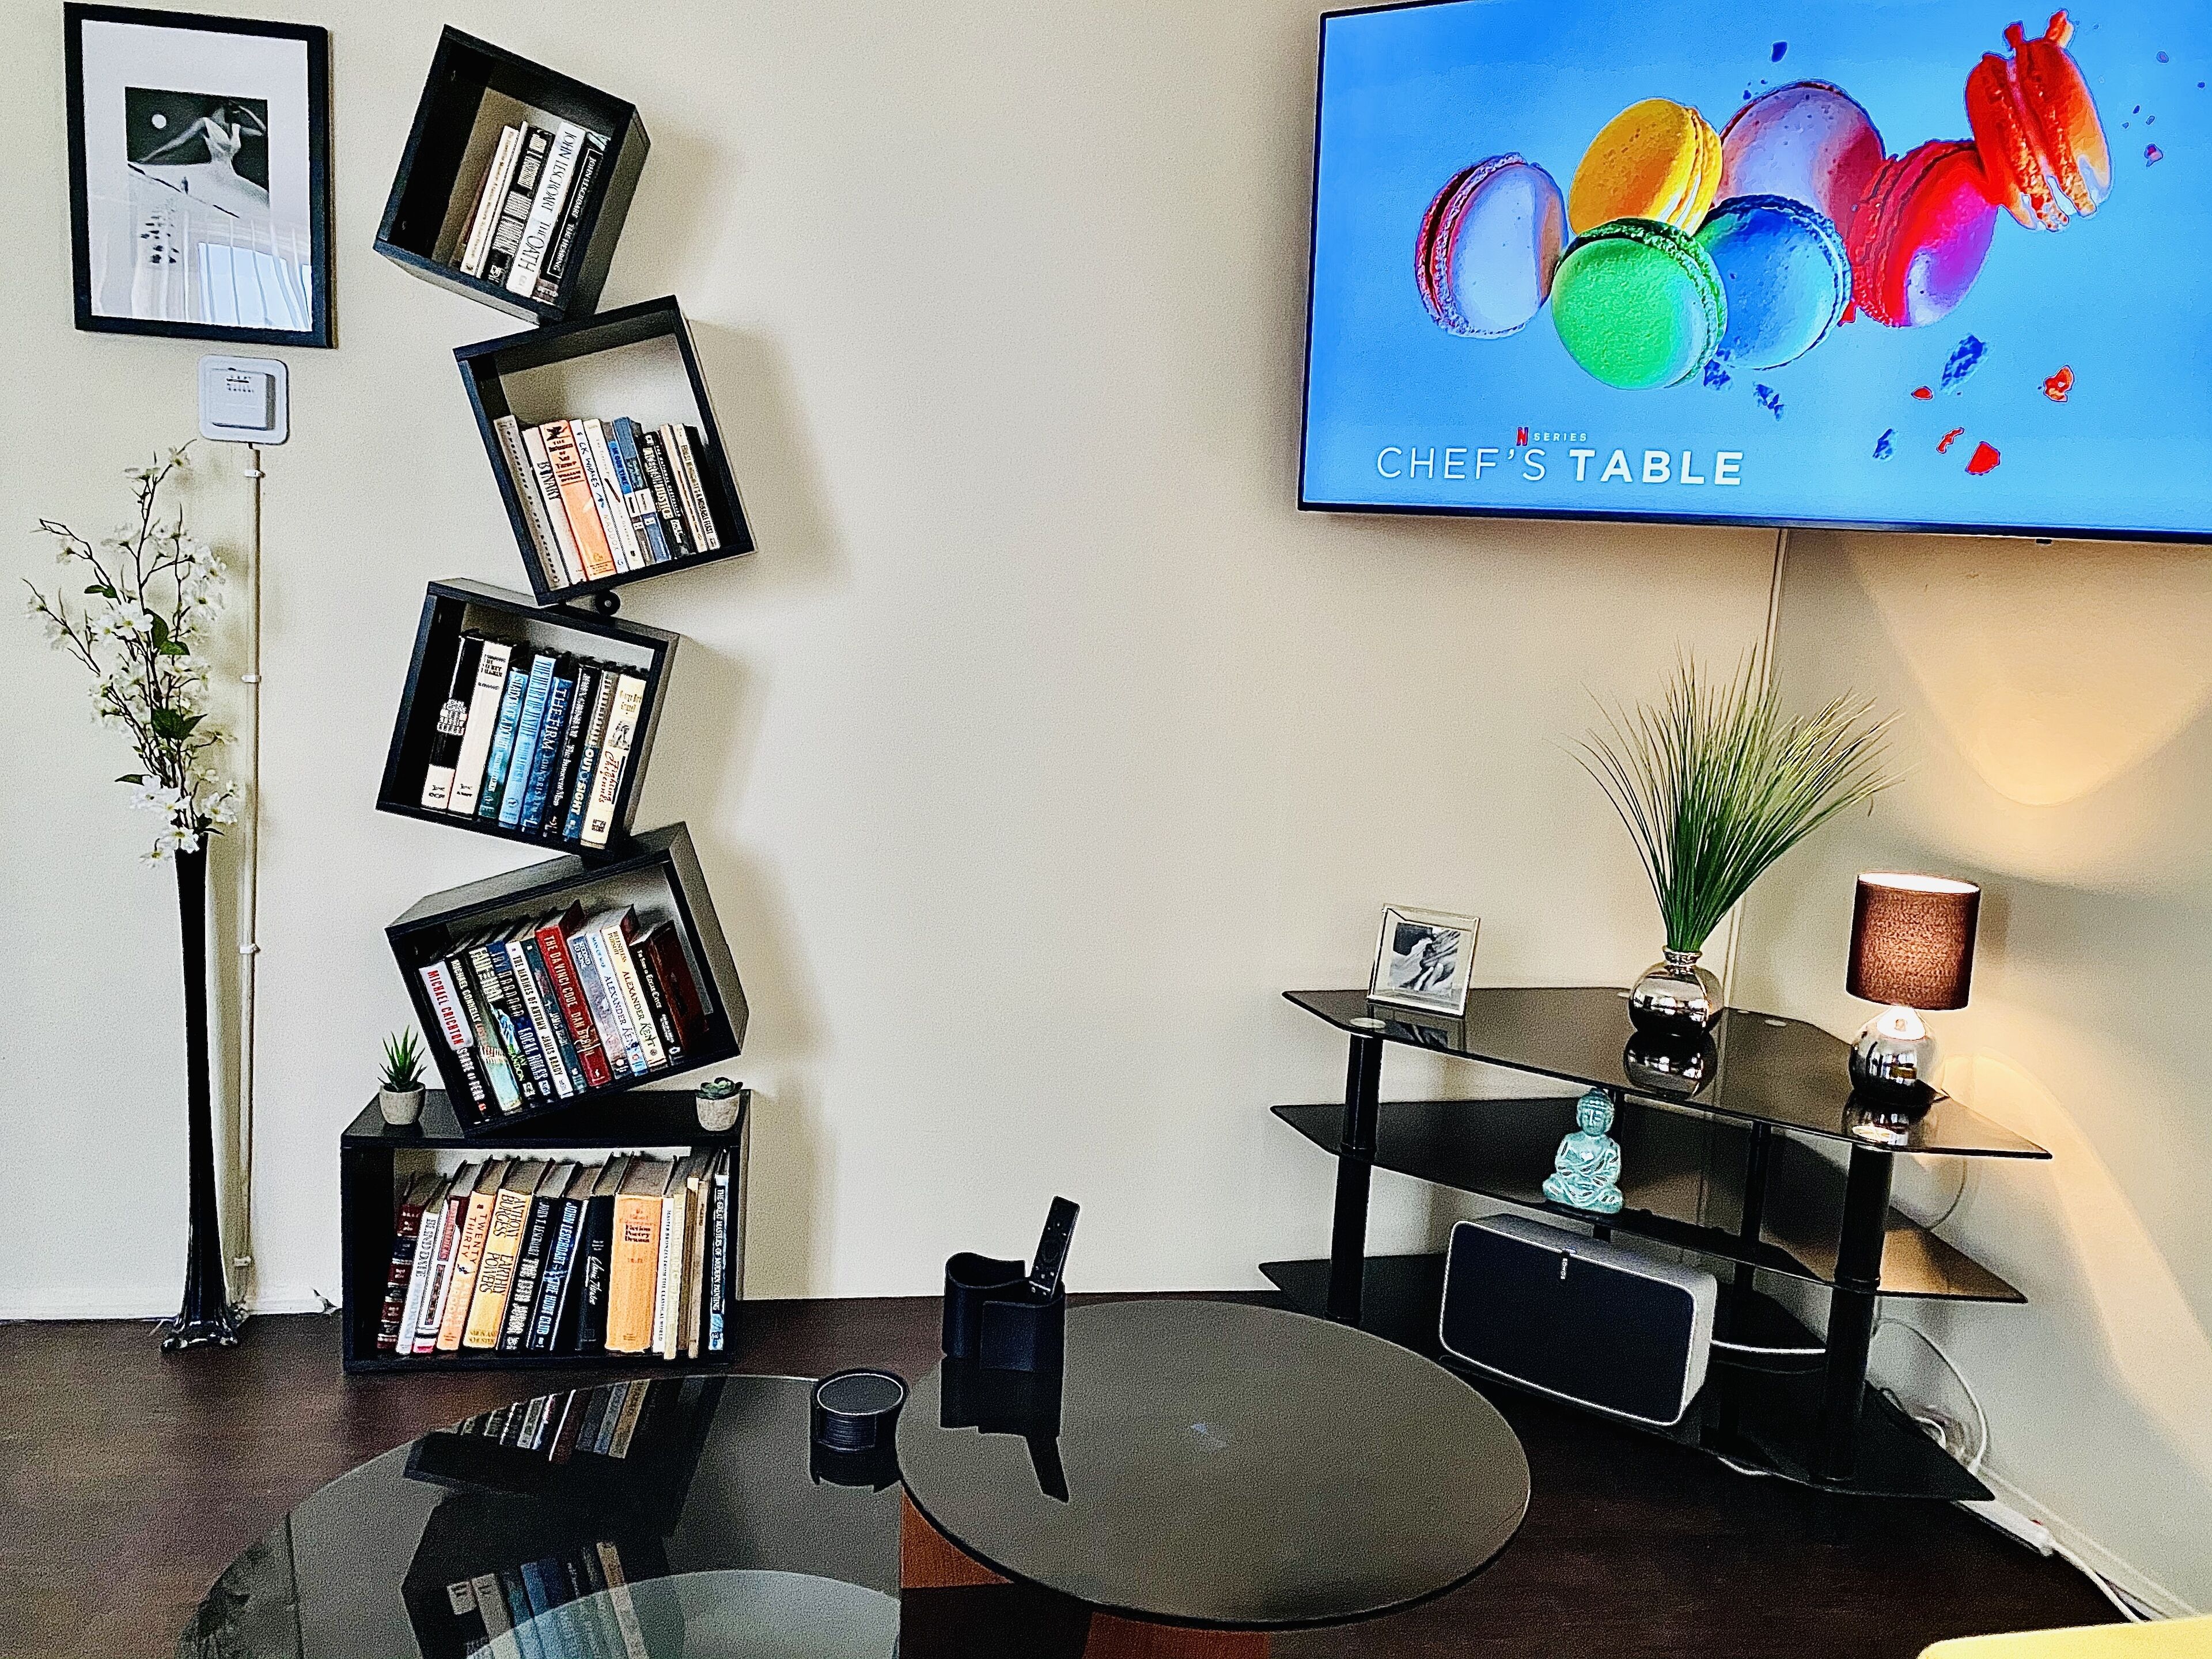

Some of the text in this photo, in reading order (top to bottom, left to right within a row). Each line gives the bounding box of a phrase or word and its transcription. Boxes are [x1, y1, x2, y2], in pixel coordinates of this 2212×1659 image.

[584, 156, 597, 178] JOHN
[517, 131, 577, 272] JOHN LESCROART THE OATH
[552, 238, 569, 271] HEARING
[1516, 426, 1588, 446] N SERIES
[1377, 446, 1744, 486] CHEF'S TABLE
[537, 460, 562, 503] BINARY
[584, 457, 600, 488] WHALES
[603, 514, 619, 551] MADDOX
[533, 660, 551, 678] THE
[504, 675, 524, 707] SHADOW
[548, 687, 566, 715] THE
[502, 708, 516, 720] OF
[494, 724, 513, 750] DOUBT
[541, 716, 560, 750] FIRM
[539, 754, 550, 774] JOHN
[564, 744, 574, 758] The
[580, 748, 594, 772] OUT
[597, 751, 614, 803] Cheyennes
[605, 759, 619, 802] Fighting
[570, 781, 586, 815] SIGHT
[543, 935, 558, 951] THE
[573, 943, 586, 969] TO NONE
[578, 940, 592, 965] SECOND
[607, 933, 619, 955] PURSUIT
[612, 931, 627, 963] RELENTLESS
[512, 955, 523, 967] THE
[549, 952, 562, 964] DA
[517, 968, 533, 995] MARINES
[553, 963, 570, 986] VINCI
[450, 959, 468, 989] MICHAEL
[461, 989, 481, 1022] CONNELLY
[527, 996, 537, 1005] OF
[561, 986, 577, 1007] CODE
[530, 1005, 546, 1031] AUTUMN
[570, 1012, 585, 1028] DAN
[604, 975, 626, 1025] ALEXANDER
[622, 1025, 635, 1048] KEN
[622, 970, 658, 1048] ALEXANDER KENT
[427, 970, 449, 1005] MICHAEL
[441, 1006, 464, 1045] CRICHTON
[456, 1047, 474, 1072] STATE
[468, 1080, 486, 1101] FEAR
[517, 1027, 539, 1055] LOCAL
[541, 1035, 555, 1055] JAMES
[517, 1055, 527, 1066] JAY
[527, 1054, 548, 1080] RULES
[548, 1056, 563, 1076] BRADY
[492, 1194, 514, 1237] BURGESS
[505, 1196, 526, 1239] ANTHONY
[536, 1202, 550, 1218] JOHN
[562, 1202, 577, 1223] JOHN
[421, 1218, 435, 1250] BLIND
[460, 1216, 476, 1257] THIRTY
[469, 1213, 487, 1264] TWENTY
[552, 1224, 573, 1265] LESCROART
[626, 1230, 649, 1238] Poetry
[415, 1251, 429, 1278] DATE
[715, 1248, 721, 1256] OF
[478, 1252, 499, 1293] POWERS
[491, 1254, 513, 1295] EARTHLY
[518, 1257, 539, 1278] THE
[545, 1279, 559, 1294] THE
[540, 1294, 556, 1316] HUNT
[536, 1315, 551, 1335] CLUB
